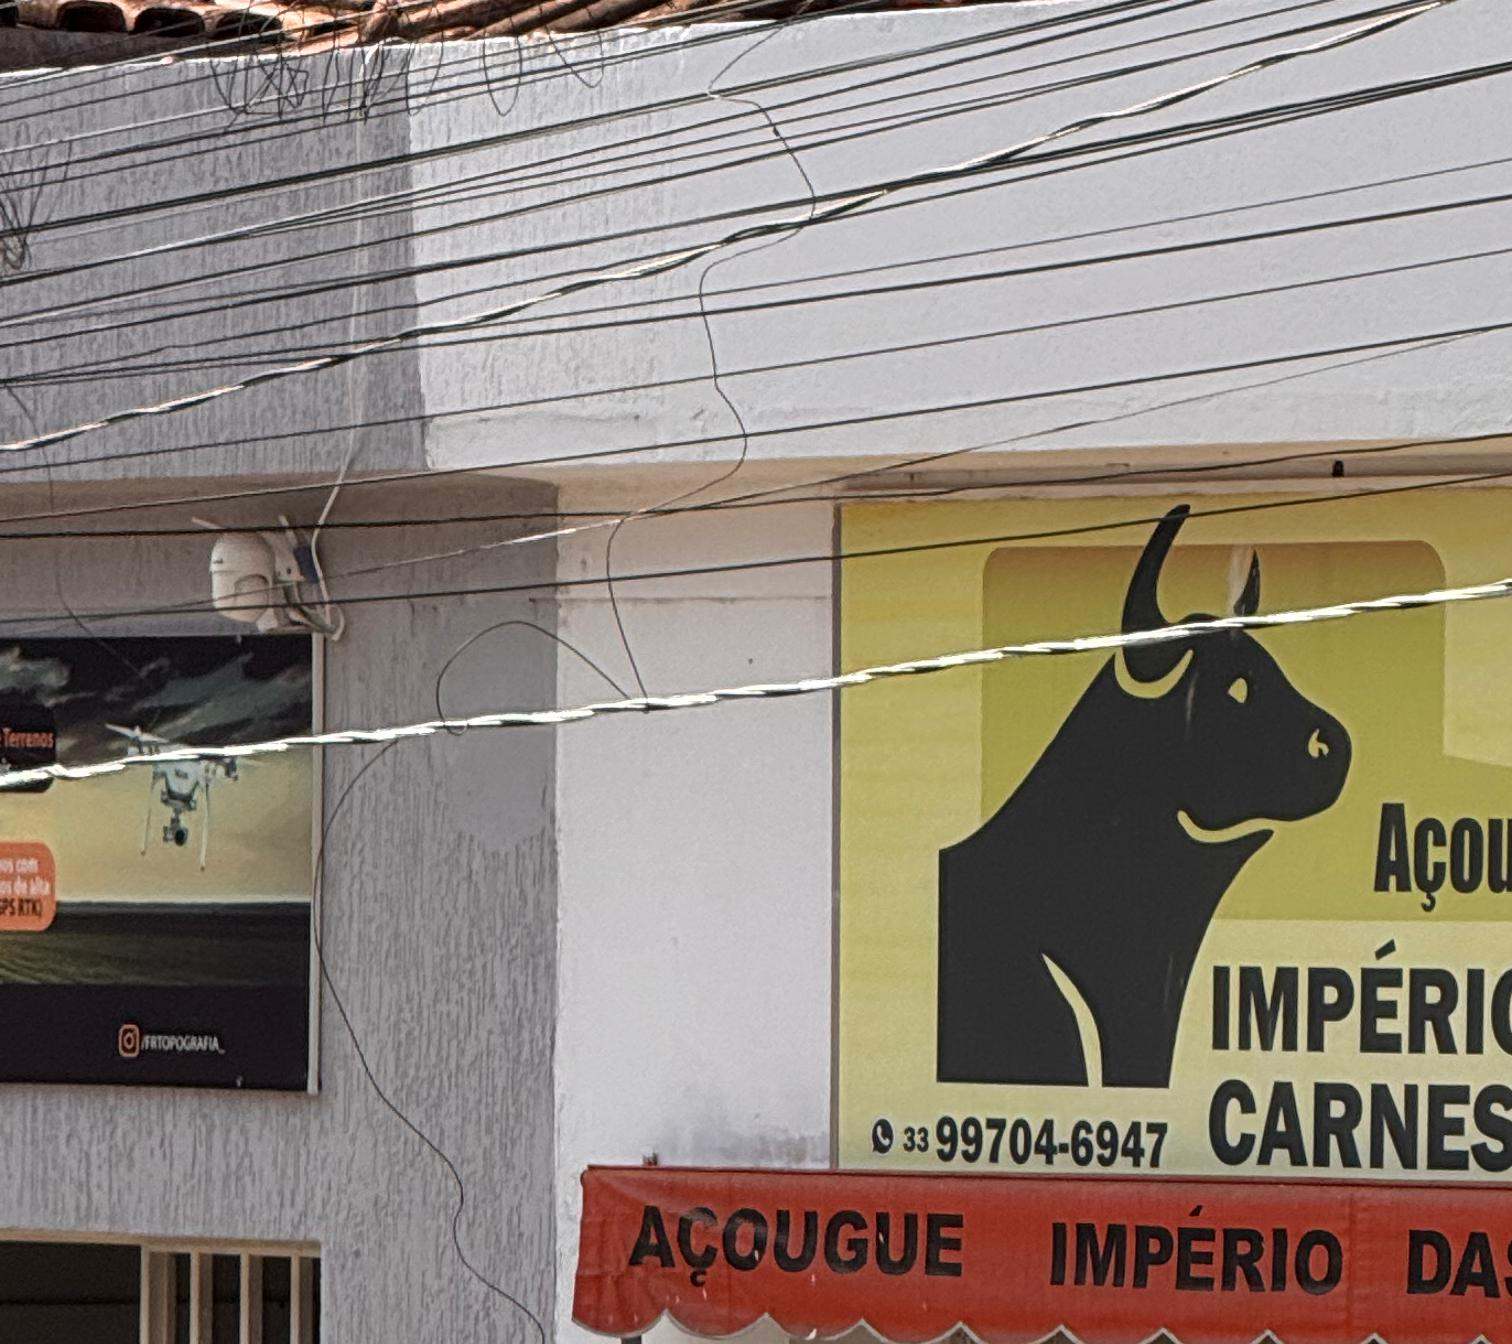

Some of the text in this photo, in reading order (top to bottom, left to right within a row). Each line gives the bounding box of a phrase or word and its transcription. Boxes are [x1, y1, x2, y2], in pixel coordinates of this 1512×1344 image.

[2, 727, 54, 748] Terrenos
[15, 858, 38, 874] com
[903, 1115, 1168, 1169] 33 99704-6947
[628, 1204, 965, 1289] AÇOUGUE
[1049, 1204, 1344, 1297] IMPÉRIO
